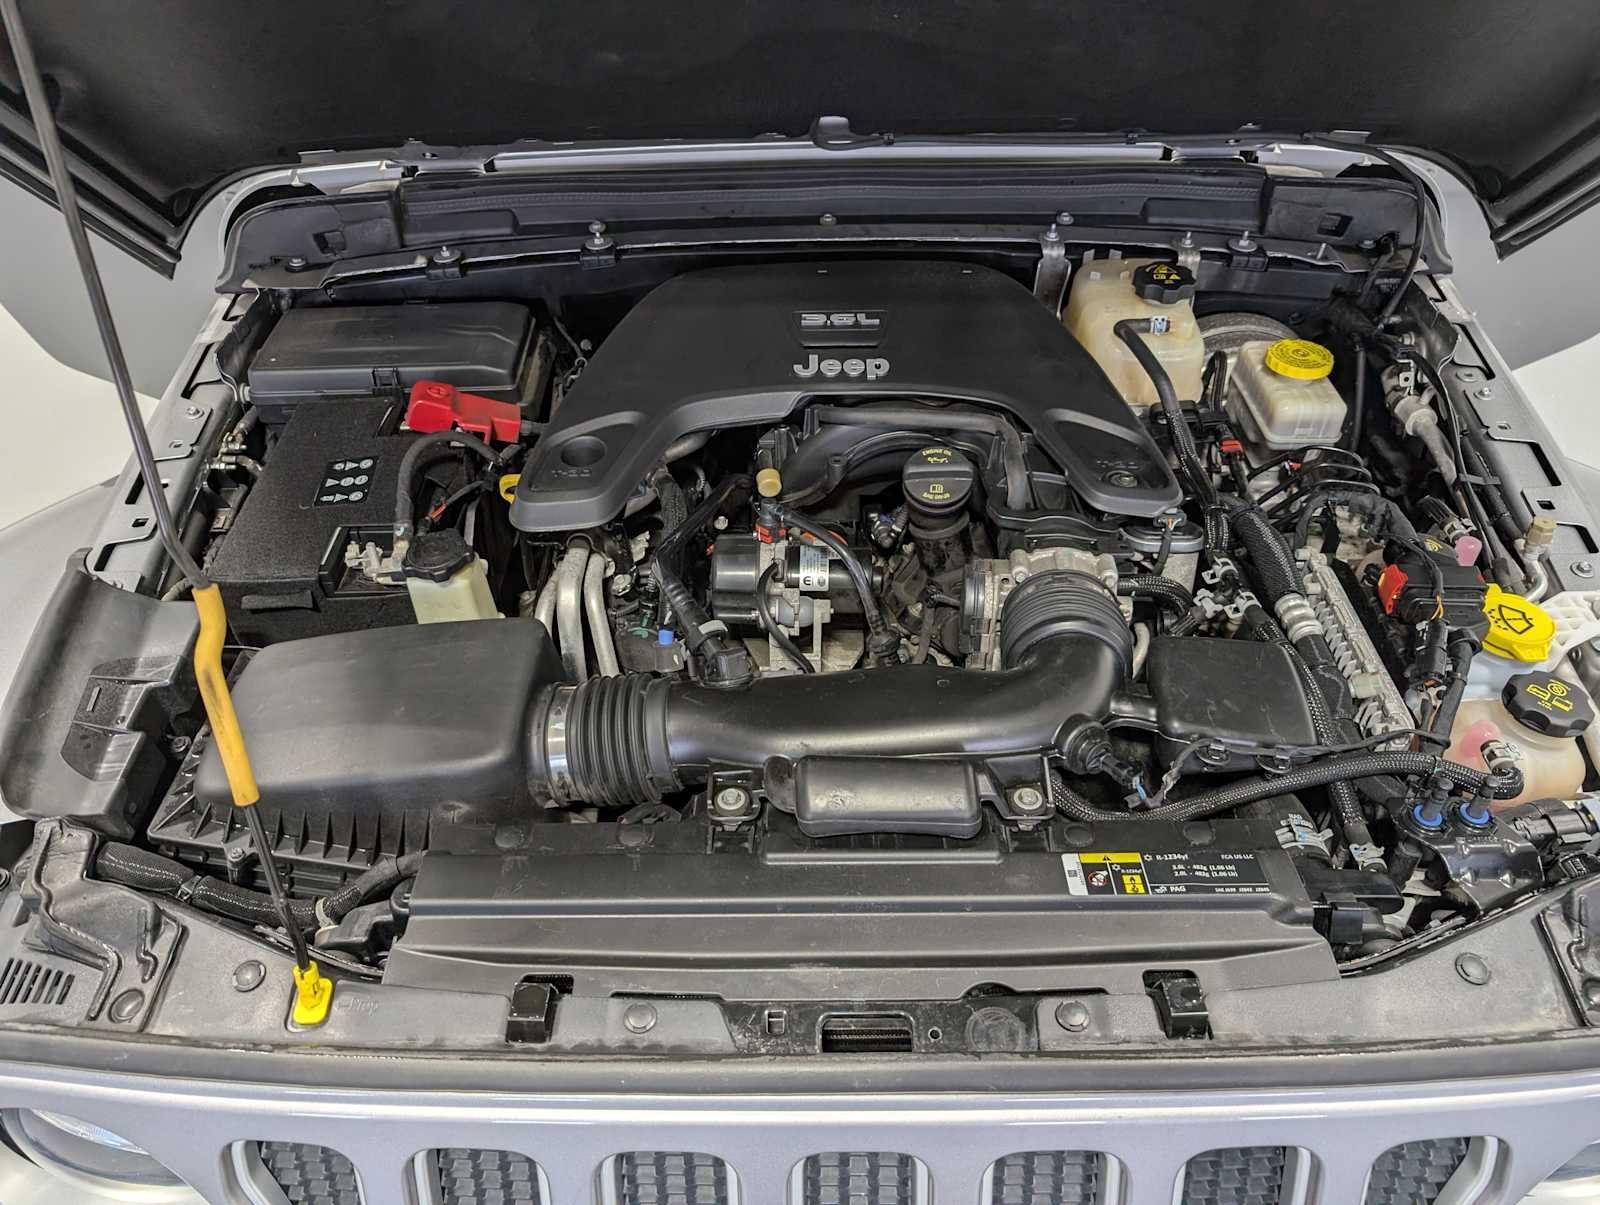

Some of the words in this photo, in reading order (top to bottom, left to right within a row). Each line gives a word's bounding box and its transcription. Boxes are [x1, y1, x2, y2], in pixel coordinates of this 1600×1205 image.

[801, 312, 880, 326] 3.6L
[793, 354, 890, 381] Jeep
[922, 448, 943, 456] ENGINE
[1156, 853, 1189, 861] R-1234yf
